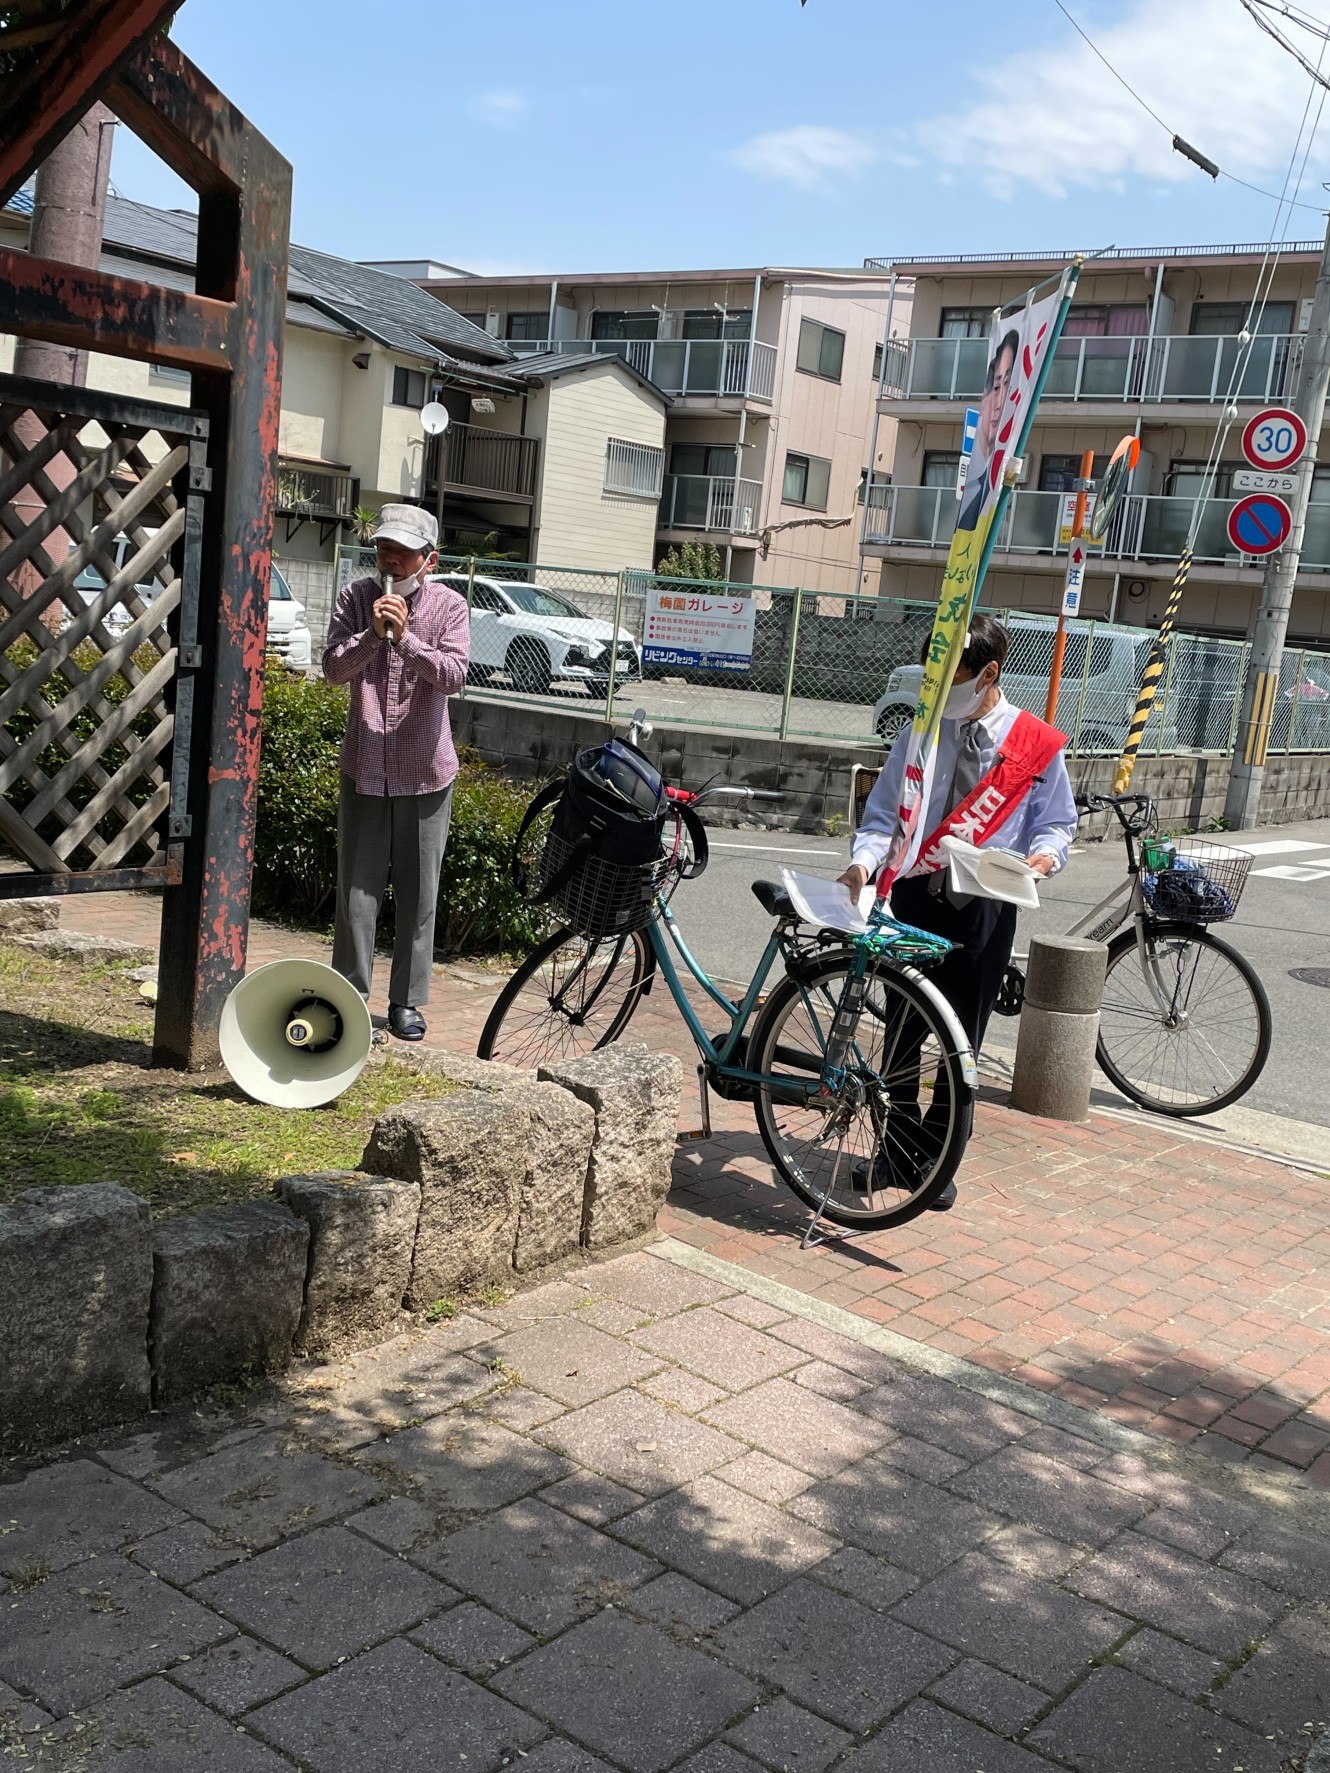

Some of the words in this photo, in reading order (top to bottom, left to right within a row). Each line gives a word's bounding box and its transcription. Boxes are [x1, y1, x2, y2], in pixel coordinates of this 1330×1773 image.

[1256, 426, 1293, 454] 30
[1239, 475, 1293, 490] ここから
[1064, 568, 1081, 609] 注意
[659, 595, 745, 615] 梅園ガレージ
[644, 648, 699, 666] リビングセンター
